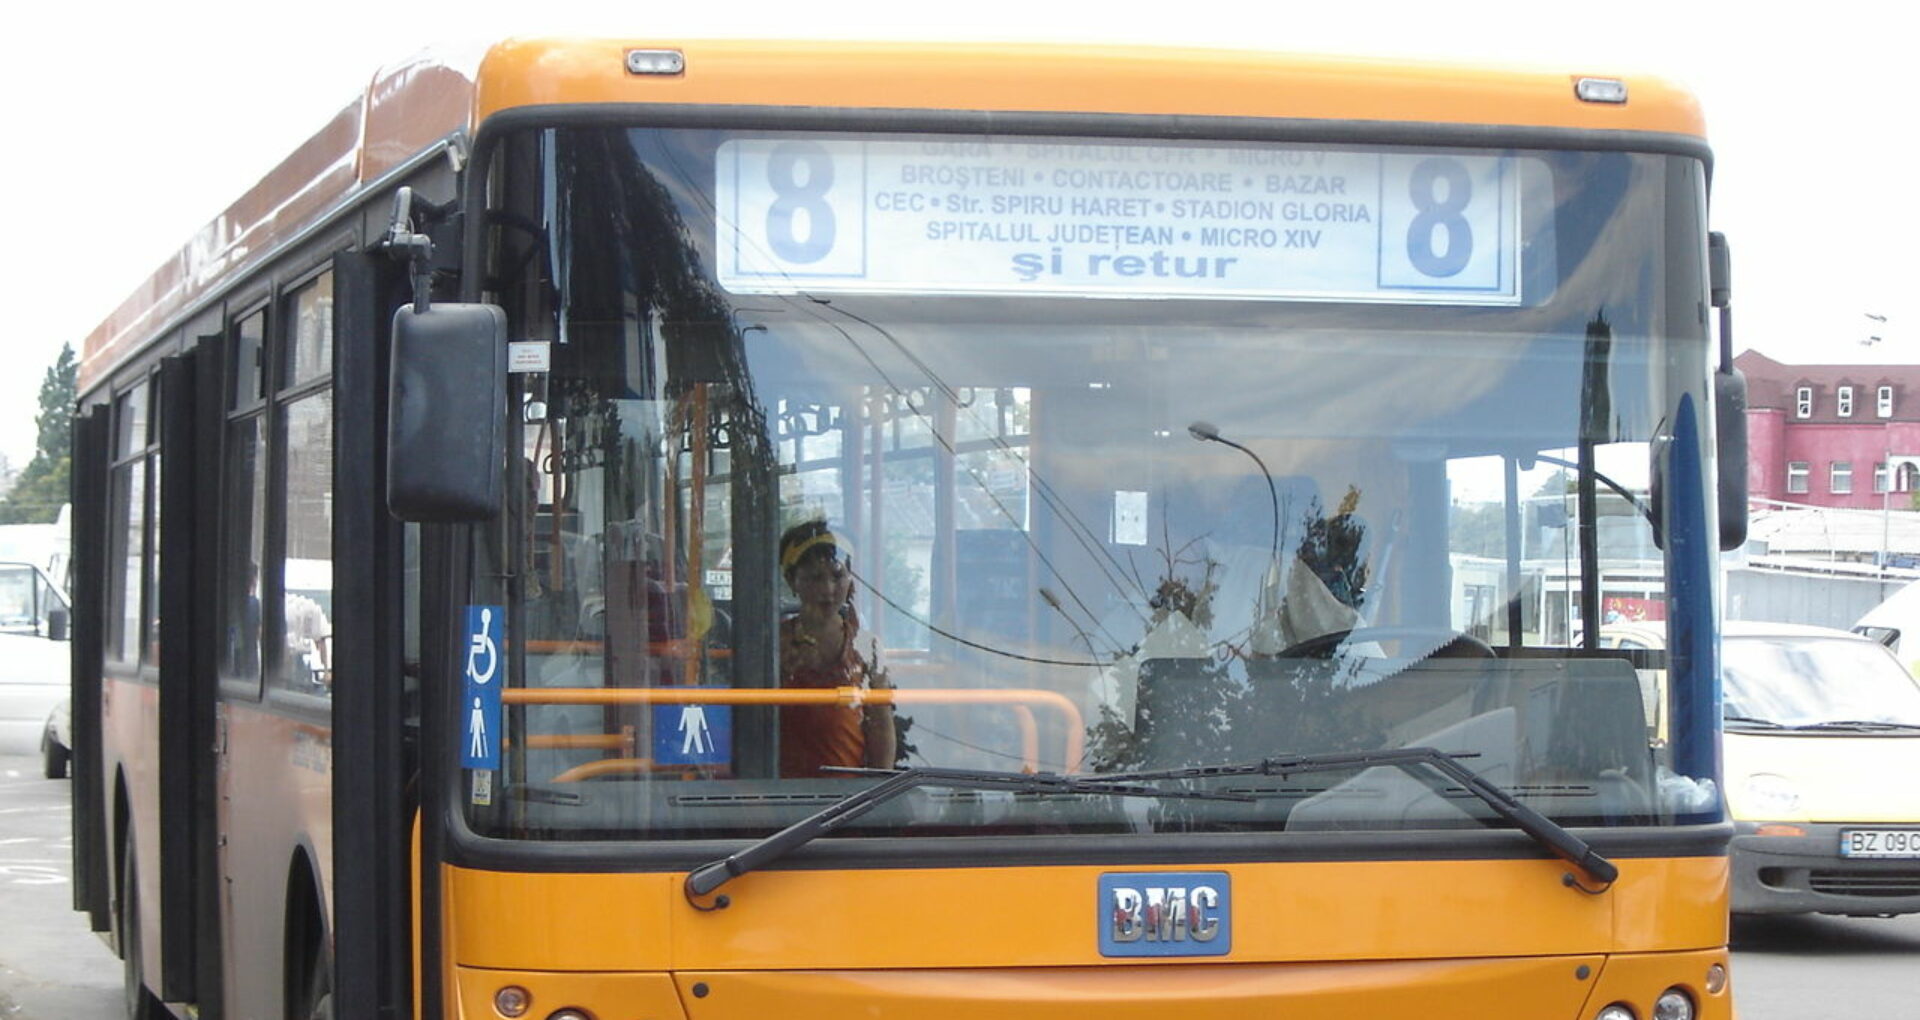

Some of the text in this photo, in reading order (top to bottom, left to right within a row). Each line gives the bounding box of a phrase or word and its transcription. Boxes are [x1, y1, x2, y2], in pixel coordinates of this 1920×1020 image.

[922, 144, 991, 158] GARA
[1026, 146, 1140, 161] SPITALUL
[1228, 151, 1304, 167] MICRO
[1052, 169, 1232, 192] CONTACTOARE
[1265, 174, 1345, 194] BAZAR
[766, 140, 836, 265] 8
[875, 192, 1371, 222] CEC Str. SPIRU HARET STADION GLORIA
[1406, 157, 1473, 278] 8
[926, 222, 1041, 242] SPITALUL
[1201, 227, 1277, 248] MICRO
[1284, 229, 1323, 248] XIV
[1088, 251, 1238, 278] retur
[1852, 833, 1877, 851] BZ
[1112, 886, 1219, 942] BMC
